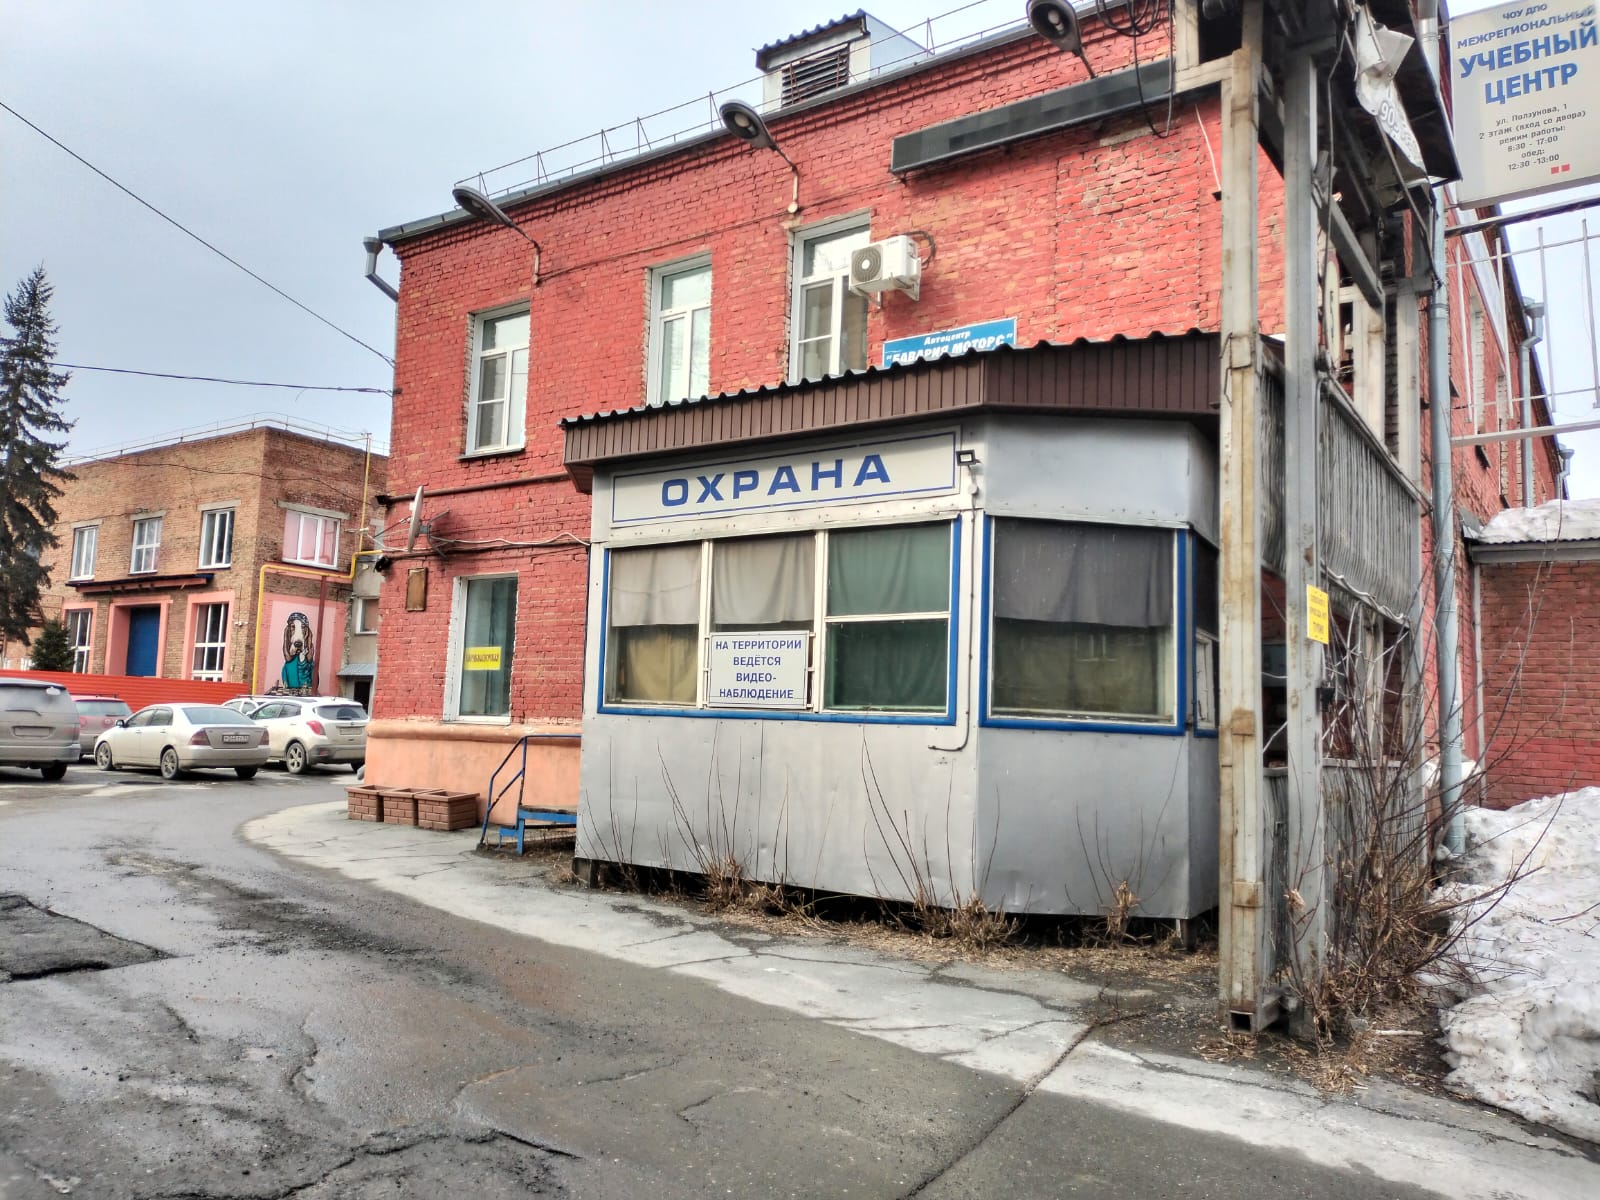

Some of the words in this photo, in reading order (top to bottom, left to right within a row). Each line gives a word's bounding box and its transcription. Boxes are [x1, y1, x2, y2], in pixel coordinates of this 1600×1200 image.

[1502, 9, 1524, 20] ЧОУ
[1525, 3, 1548, 16] ДПО
[1457, 4, 1596, 49] МЕЖРЕГИОНАЛЬНЫЙ
[1458, 19, 1598, 79] УЧЕБНЫЙ
[1485, 63, 1578, 105] ЦЕНТР
[1479, 132, 1485, 140] 2
[1488, 127, 1512, 138] этаж
[1516, 120, 1540, 132] (вход
[1543, 117, 1553, 125] со
[1556, 110, 1587, 123] двора)
[1496, 118, 1509, 127] ул.
[1511, 106, 1560, 122] Ползунова,
[1499, 133, 1528, 146] режим
[1531, 125, 1566, 139] работы:
[1507, 142, 1526, 153] 8:30
[1537, 135, 1559, 146] 17:00
[1521, 148, 1545, 159] обед:
[1508, 160, 1530, 171] 12:30
[923, 330, 971, 346] Автоцентр
[661, 454, 890, 507] ОХРАНА
[715, 640, 729, 650] НА
[732, 639, 802, 650] ТЕРРИТОРИИ
[736, 672, 777, 683] ВИДЕО-
[719, 688, 794, 700] НАБЛЮДЕНИЕ
